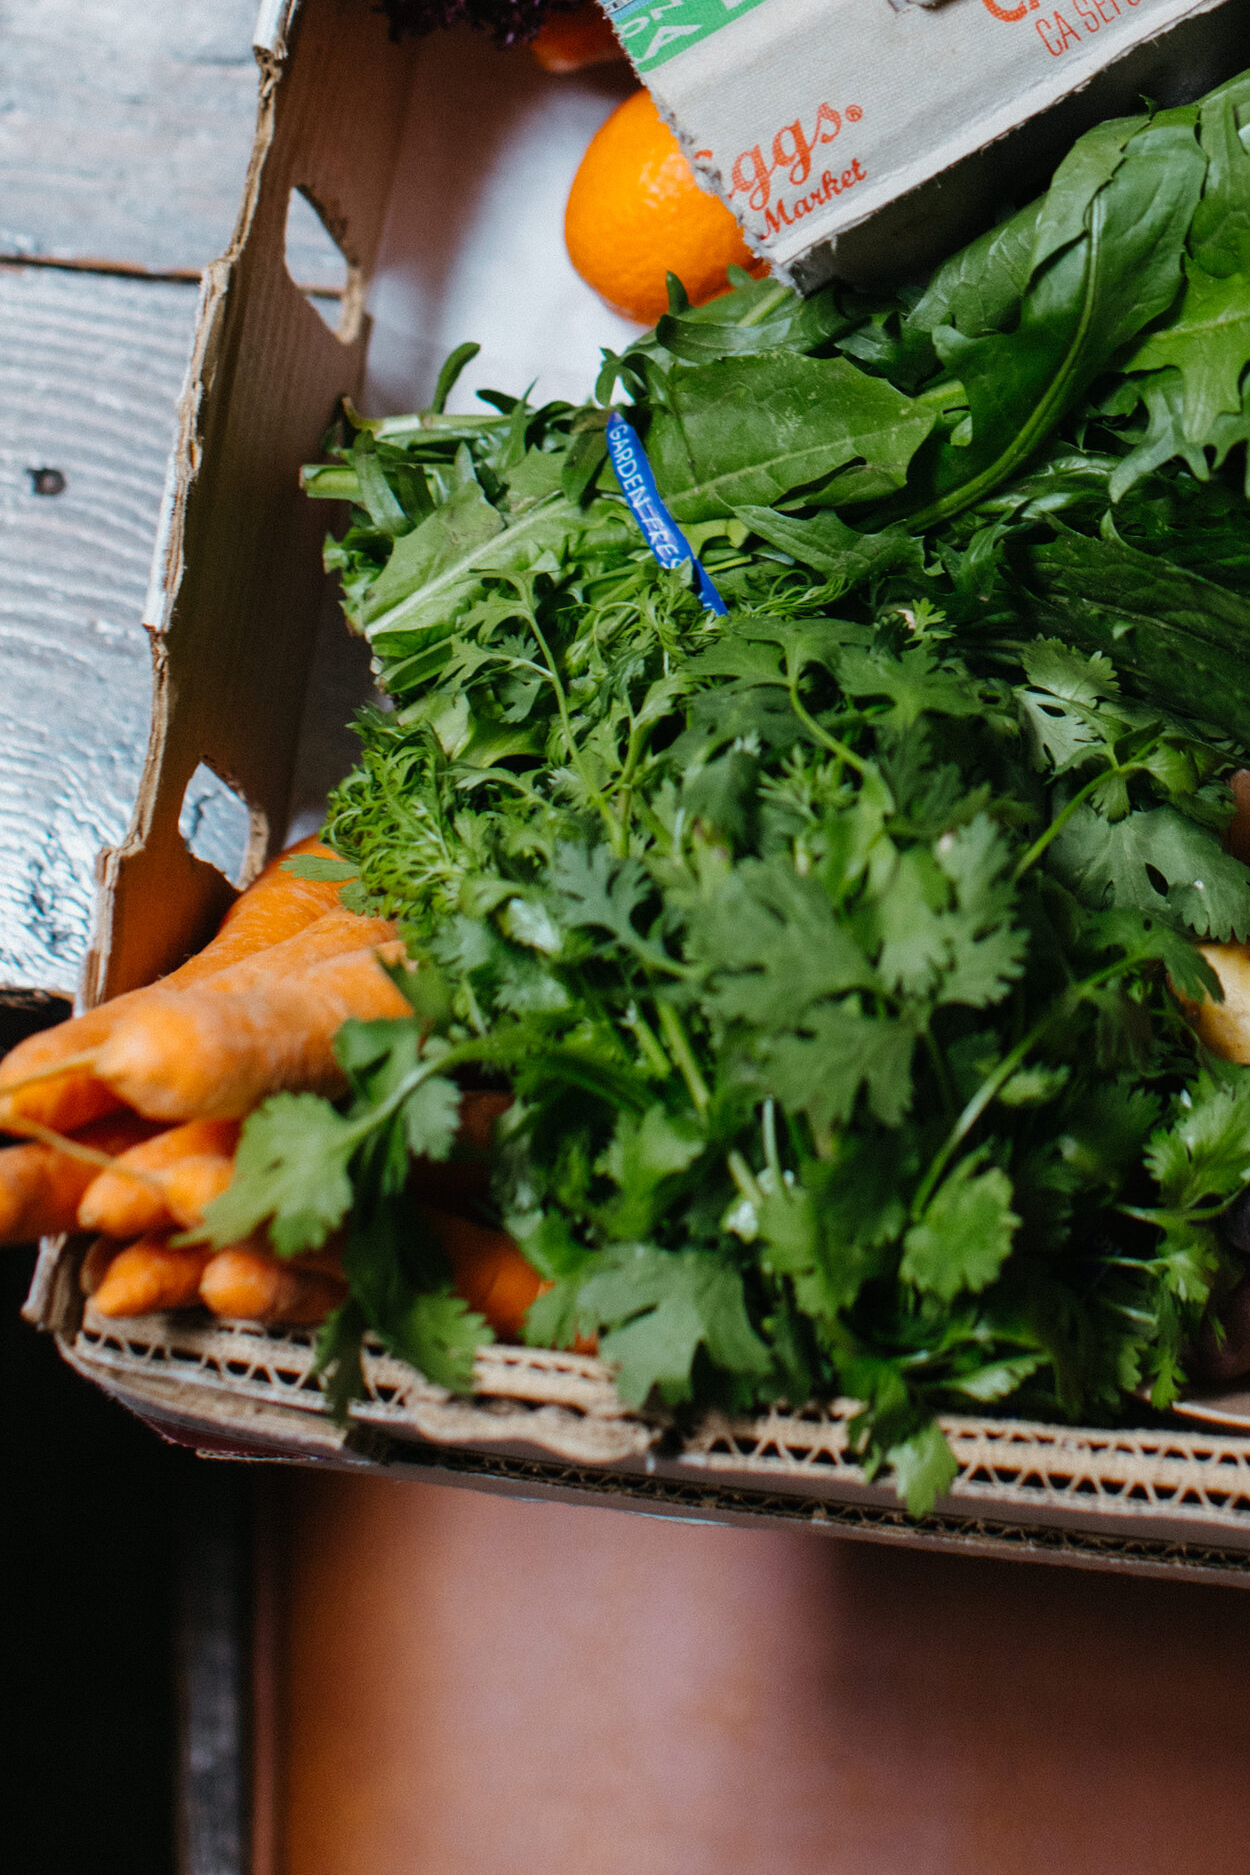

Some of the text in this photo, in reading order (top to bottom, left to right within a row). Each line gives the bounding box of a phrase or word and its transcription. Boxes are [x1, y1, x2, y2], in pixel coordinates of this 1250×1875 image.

[1035, 9, 1083, 58] CA
[760, 158, 868, 241] Market
[608, 424, 650, 509] GARDEN
